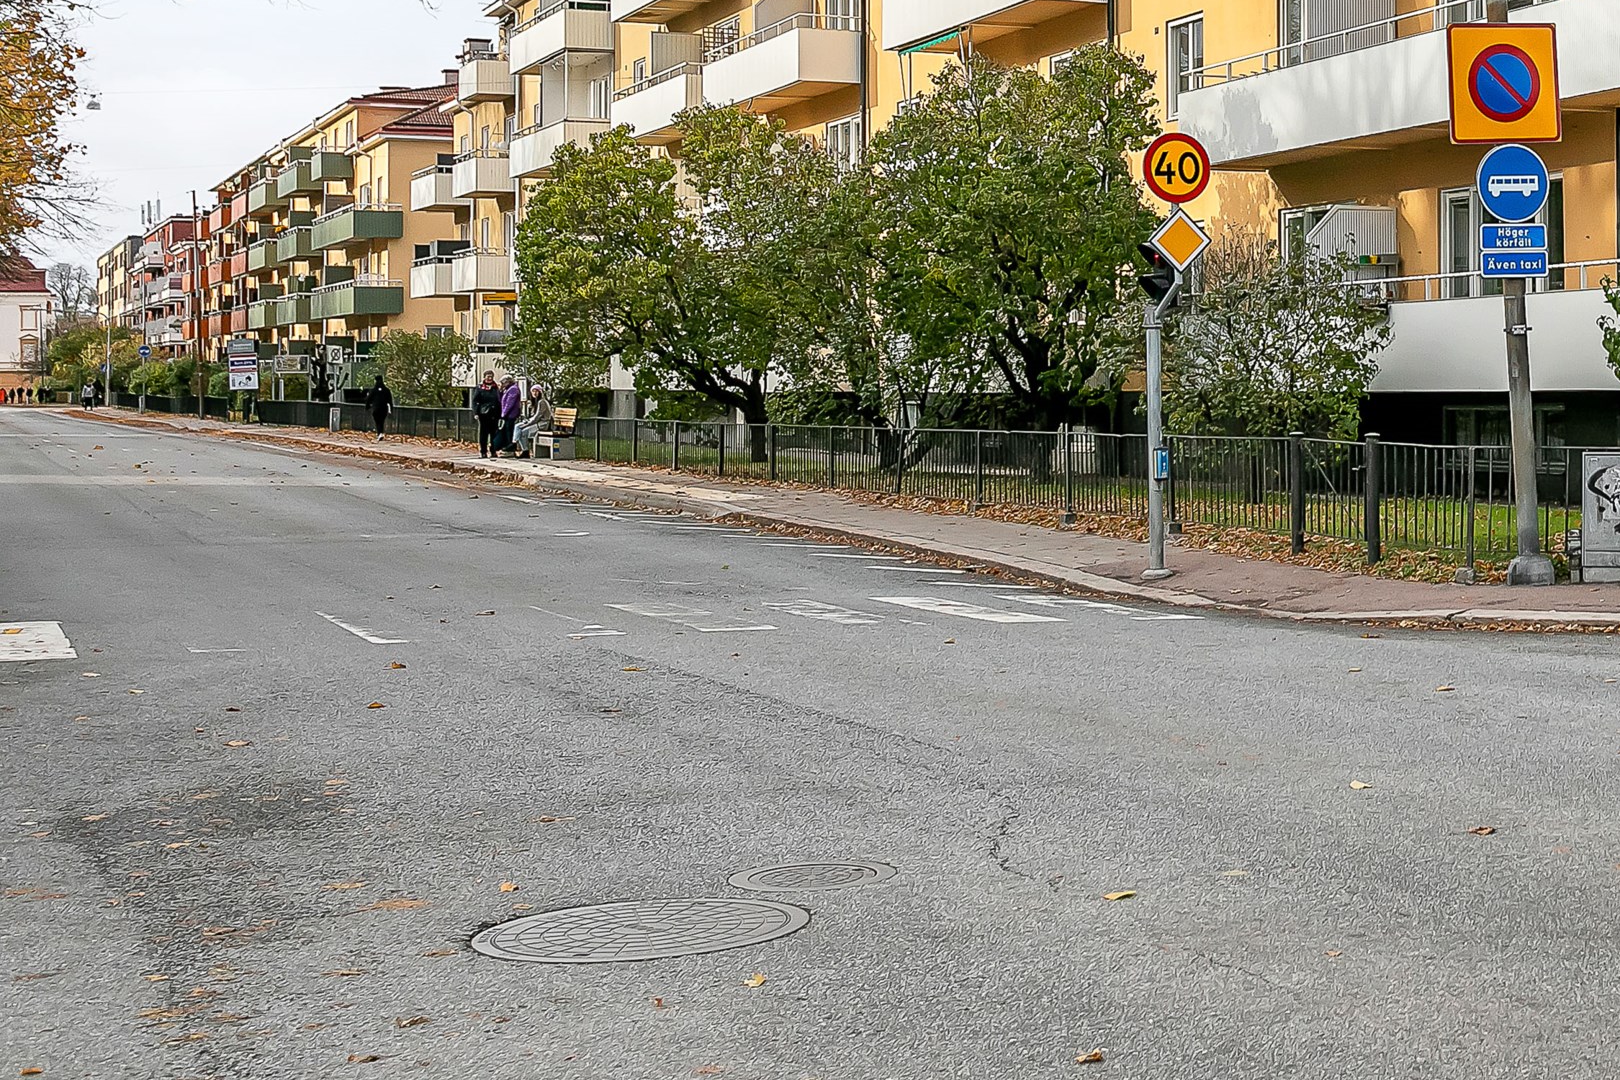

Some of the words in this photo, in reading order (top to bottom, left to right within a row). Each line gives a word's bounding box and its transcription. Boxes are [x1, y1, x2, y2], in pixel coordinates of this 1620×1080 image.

[1154, 151, 1200, 185] 40
[1497, 227, 1529, 238] Höger
[1496, 238, 1532, 247] körfält
[1487, 257, 1516, 270] Även
[1520, 259, 1542, 269] taxi
